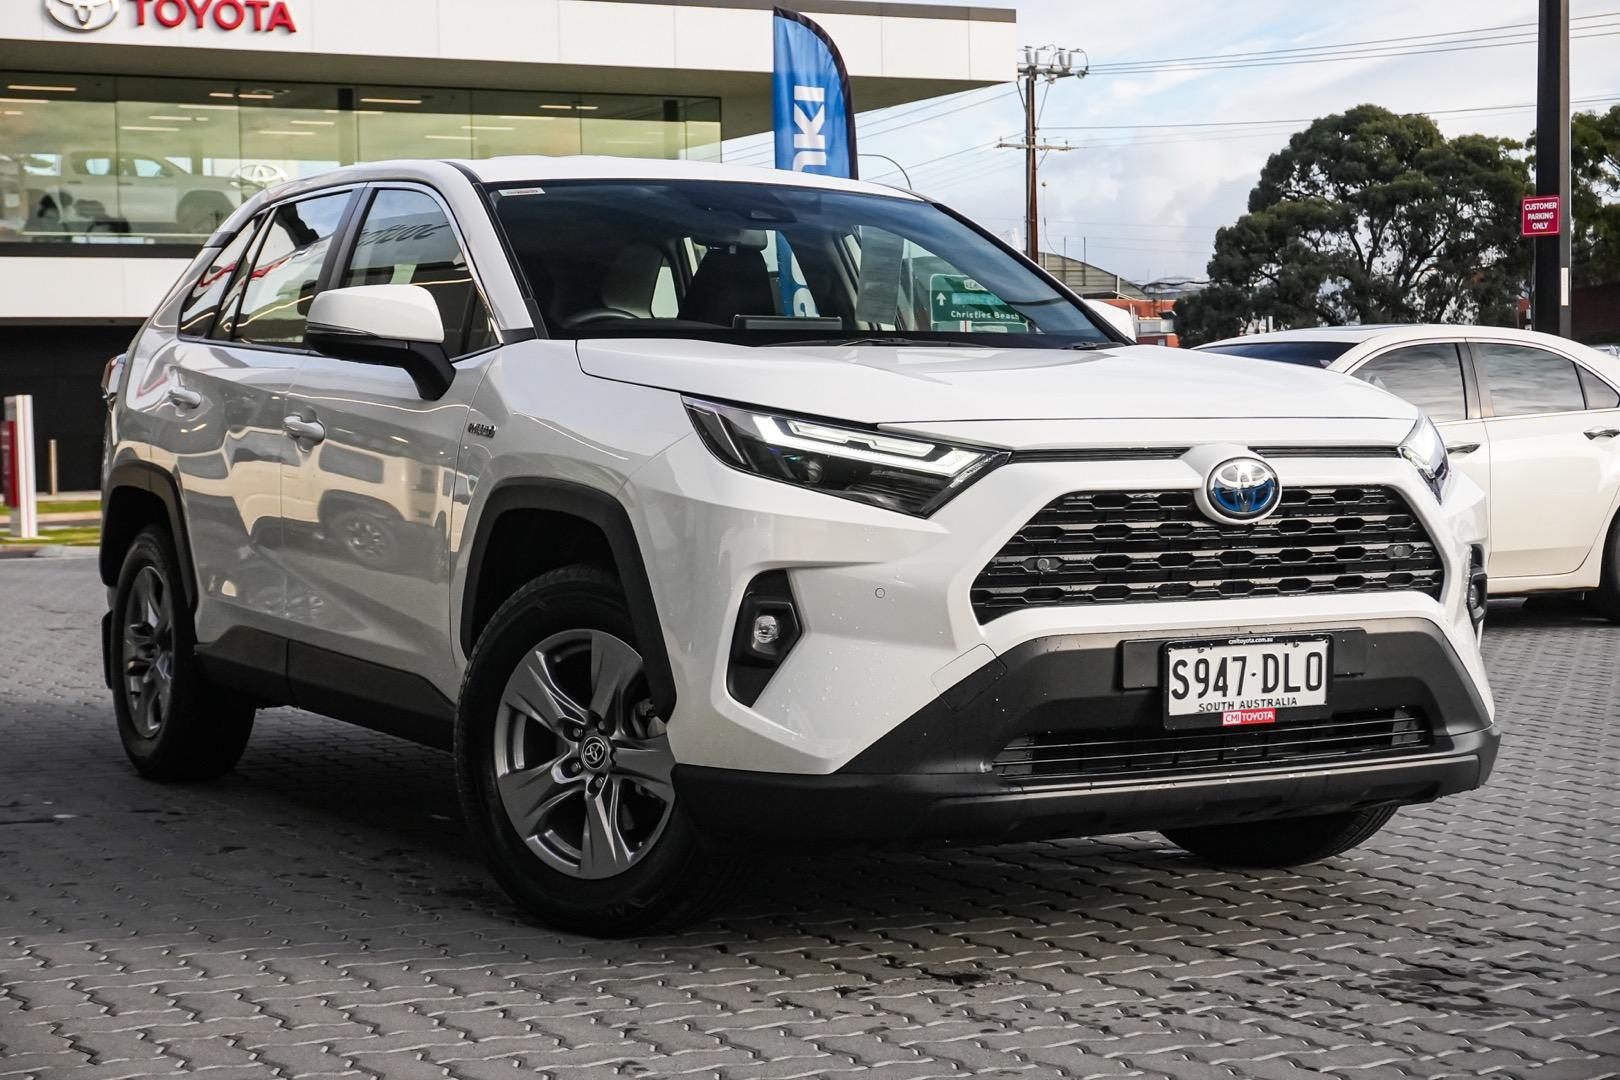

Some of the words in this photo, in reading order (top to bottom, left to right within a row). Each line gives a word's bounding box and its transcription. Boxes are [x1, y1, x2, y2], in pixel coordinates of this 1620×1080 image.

[127, 0, 297, 33] TOYOTA
[1524, 202, 1557, 211] CUSTOMER
[1527, 212, 1554, 220] PARKING
[1532, 222, 1549, 230] ONLY
[950, 310, 992, 319] Christies
[993, 311, 1020, 321] Beach
[1199, 701, 1235, 713] SOUTH
[1239, 697, 1298, 710] AUSTRALIA
[1225, 713, 1240, 723] CMI
[1241, 711, 1274, 721] TOYOTA
